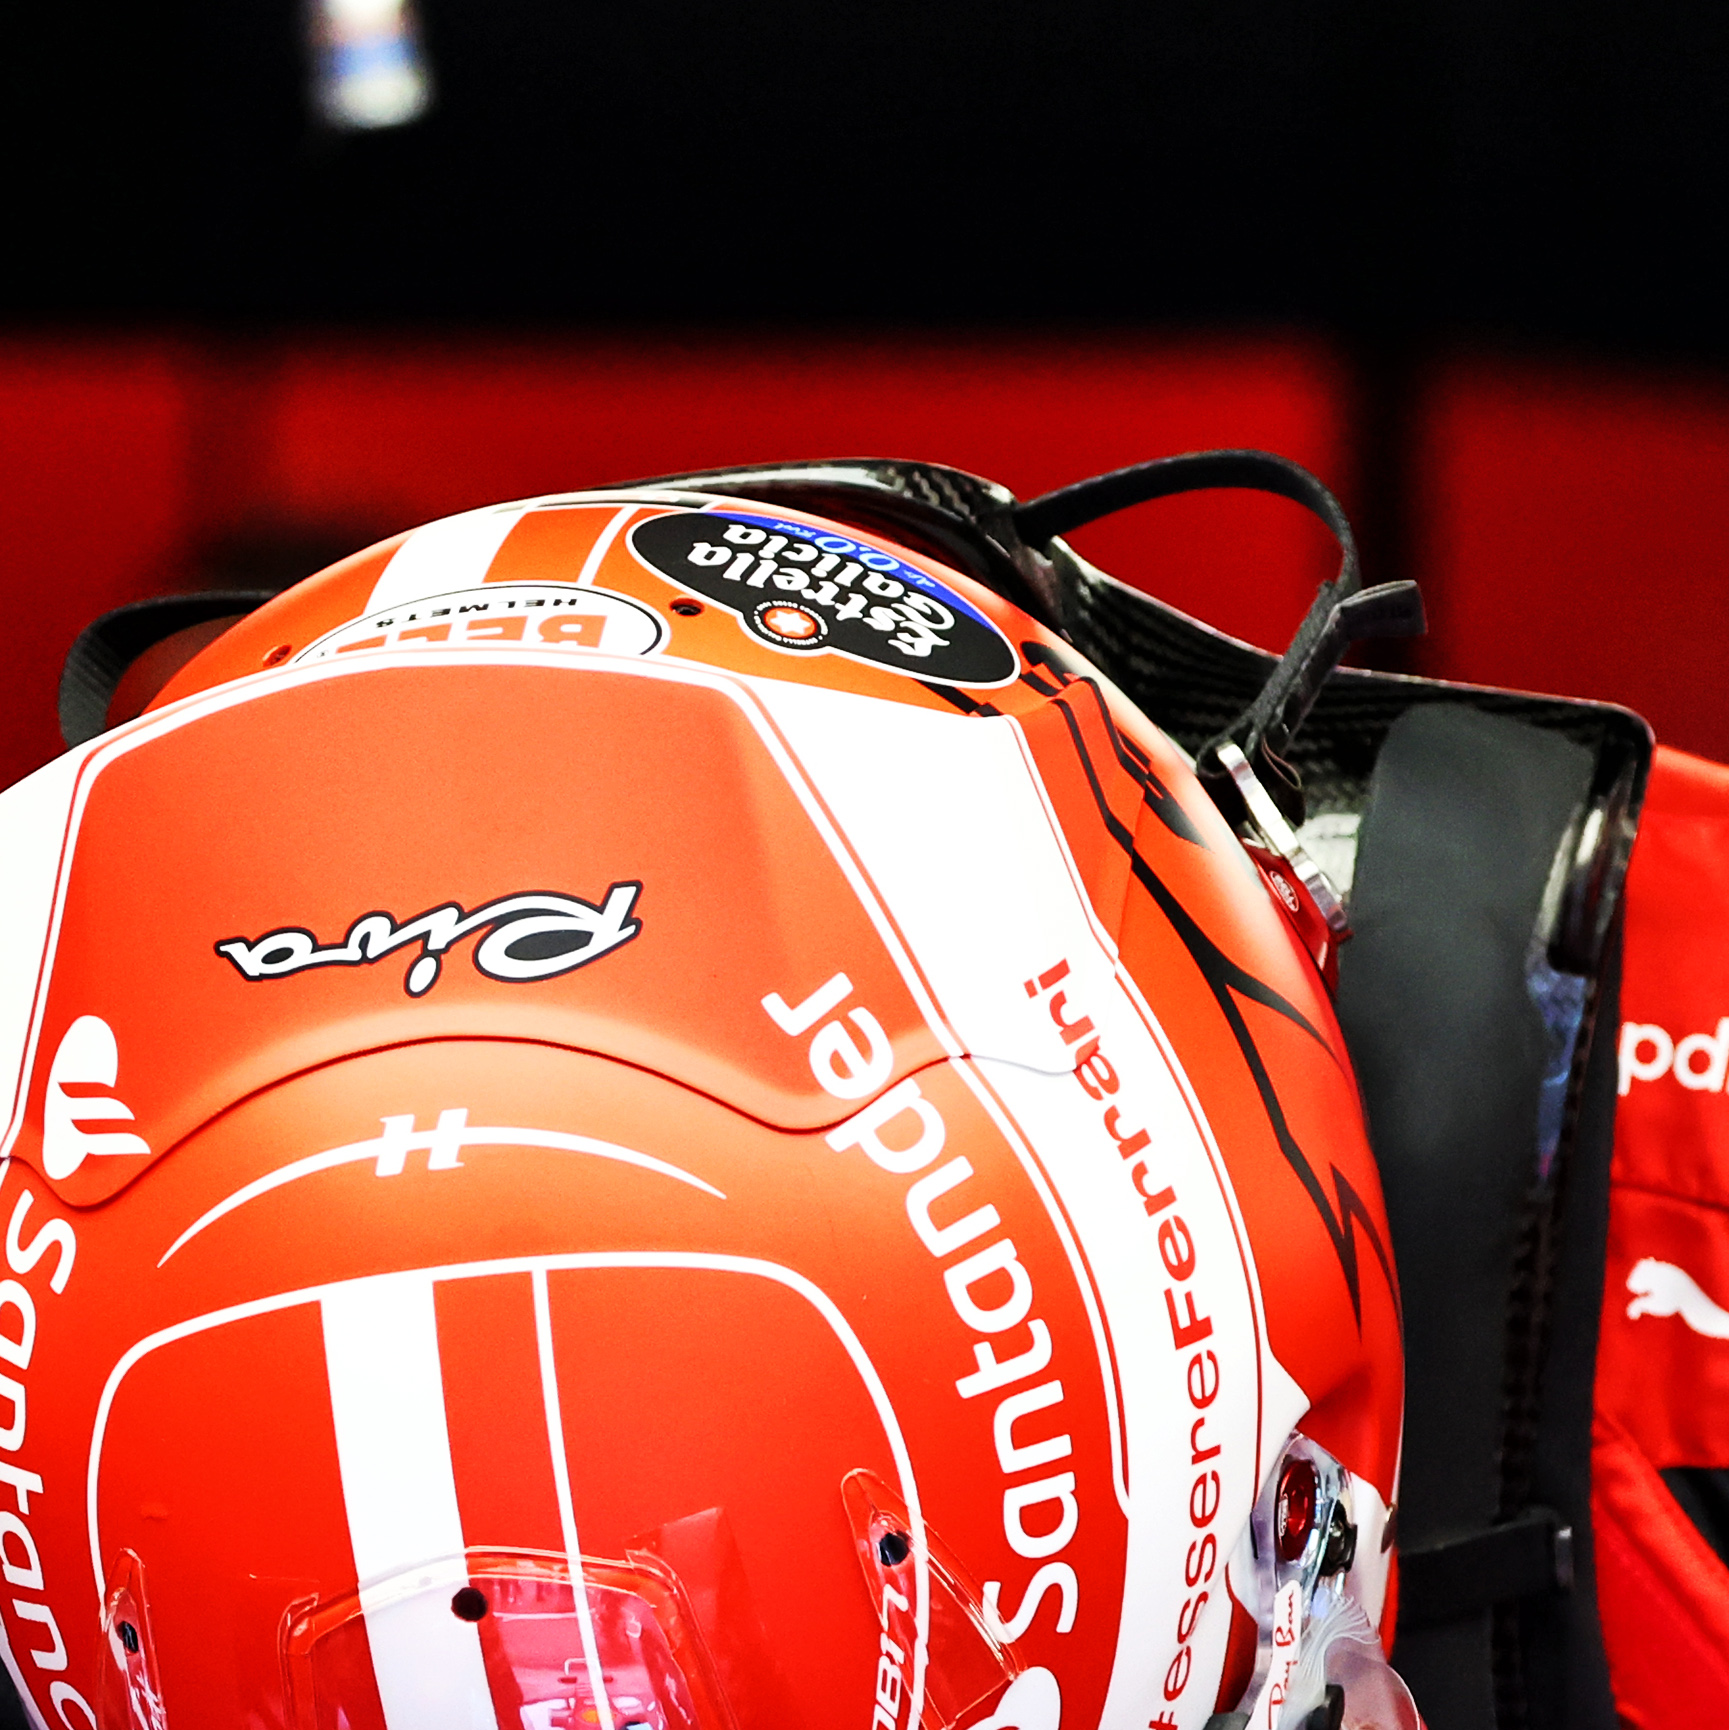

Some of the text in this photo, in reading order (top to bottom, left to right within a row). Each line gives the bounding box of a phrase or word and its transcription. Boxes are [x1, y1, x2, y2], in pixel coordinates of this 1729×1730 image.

[686, 541, 952, 658] Estrella
[722, 523, 956, 631] Galicia
[215, 880, 643, 998] Riva
[759, 971, 1080, 1645] Santander
